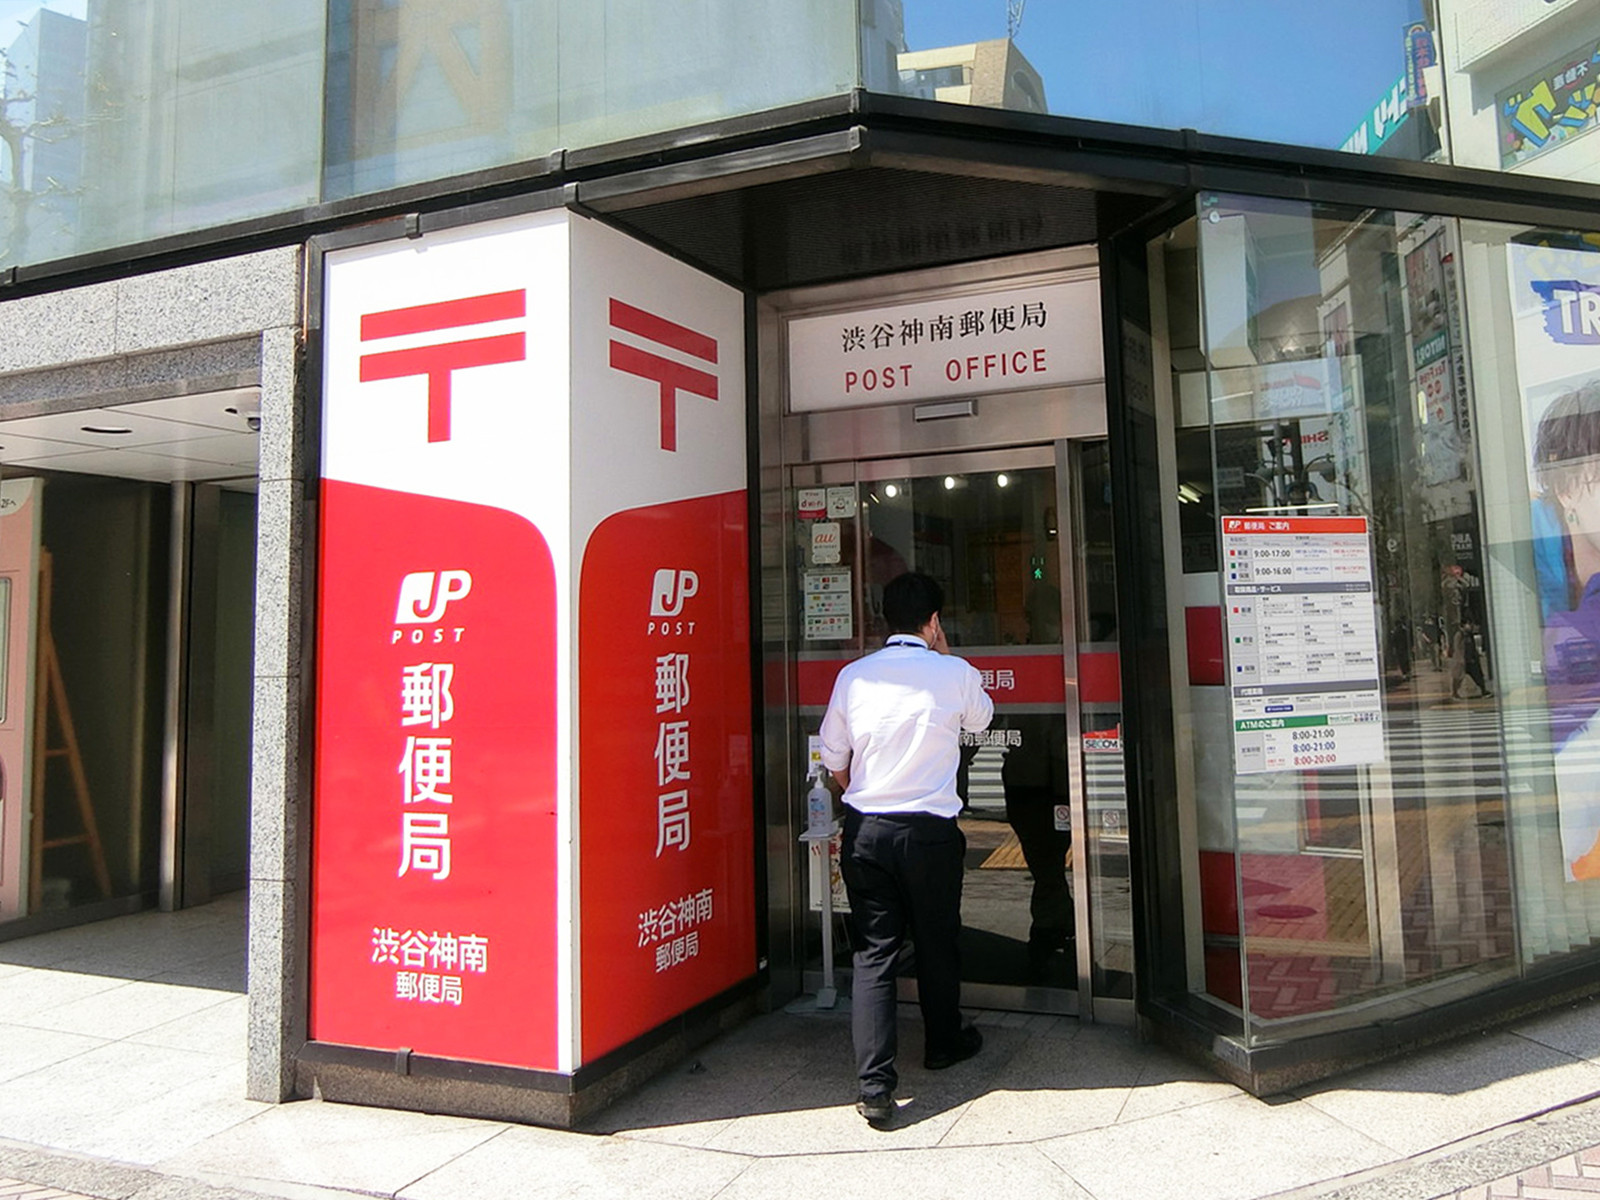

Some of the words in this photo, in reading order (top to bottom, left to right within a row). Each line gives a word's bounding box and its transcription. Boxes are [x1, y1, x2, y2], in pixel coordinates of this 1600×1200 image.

[842, 302, 1048, 353] 渋谷神南郵便局
[845, 365, 912, 393] POST
[946, 349, 1047, 382] OFFICE
[815, 534, 835, 543] au
[1255, 567, 1292, 575] 9:00-16:00
[392, 628, 464, 644] POST
[647, 622, 696, 636] POST
[1085, 739, 1118, 748] SECOM
[1292, 729, 1335, 740] 8:00-21:00
[1293, 741, 1336, 753] 8:00-21:00
[654, 652, 691, 859] 郵便局
[1294, 754, 1336, 766] 8:00-20:00
[398, 662, 455, 881] 郵便局
[638, 888, 713, 948] 渋谷神南
[372, 927, 488, 973] 渋谷神南
[656, 931, 698, 973] 郵便局
[396, 971, 463, 1005] 郵便局
